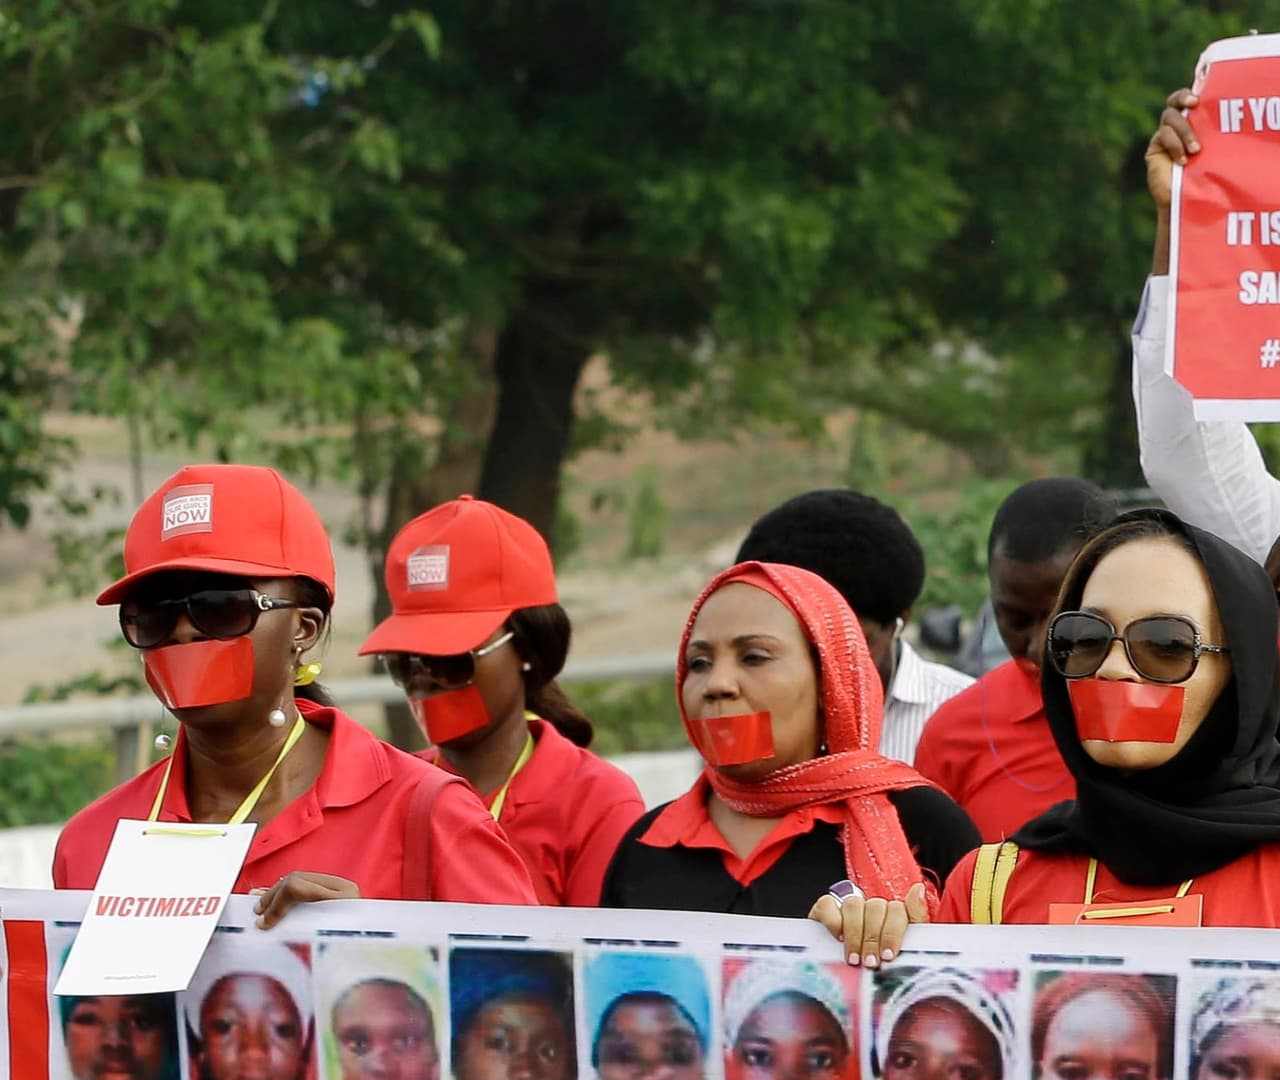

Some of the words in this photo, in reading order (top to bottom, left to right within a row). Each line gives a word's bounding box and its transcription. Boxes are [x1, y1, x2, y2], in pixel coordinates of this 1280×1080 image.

[1220, 99, 1243, 132] IF
[1227, 213, 1254, 245] IT
[165, 509, 208, 529] NOW
[410, 569, 441, 582] NOW
[95, 895, 222, 917] VICTIMIZED
